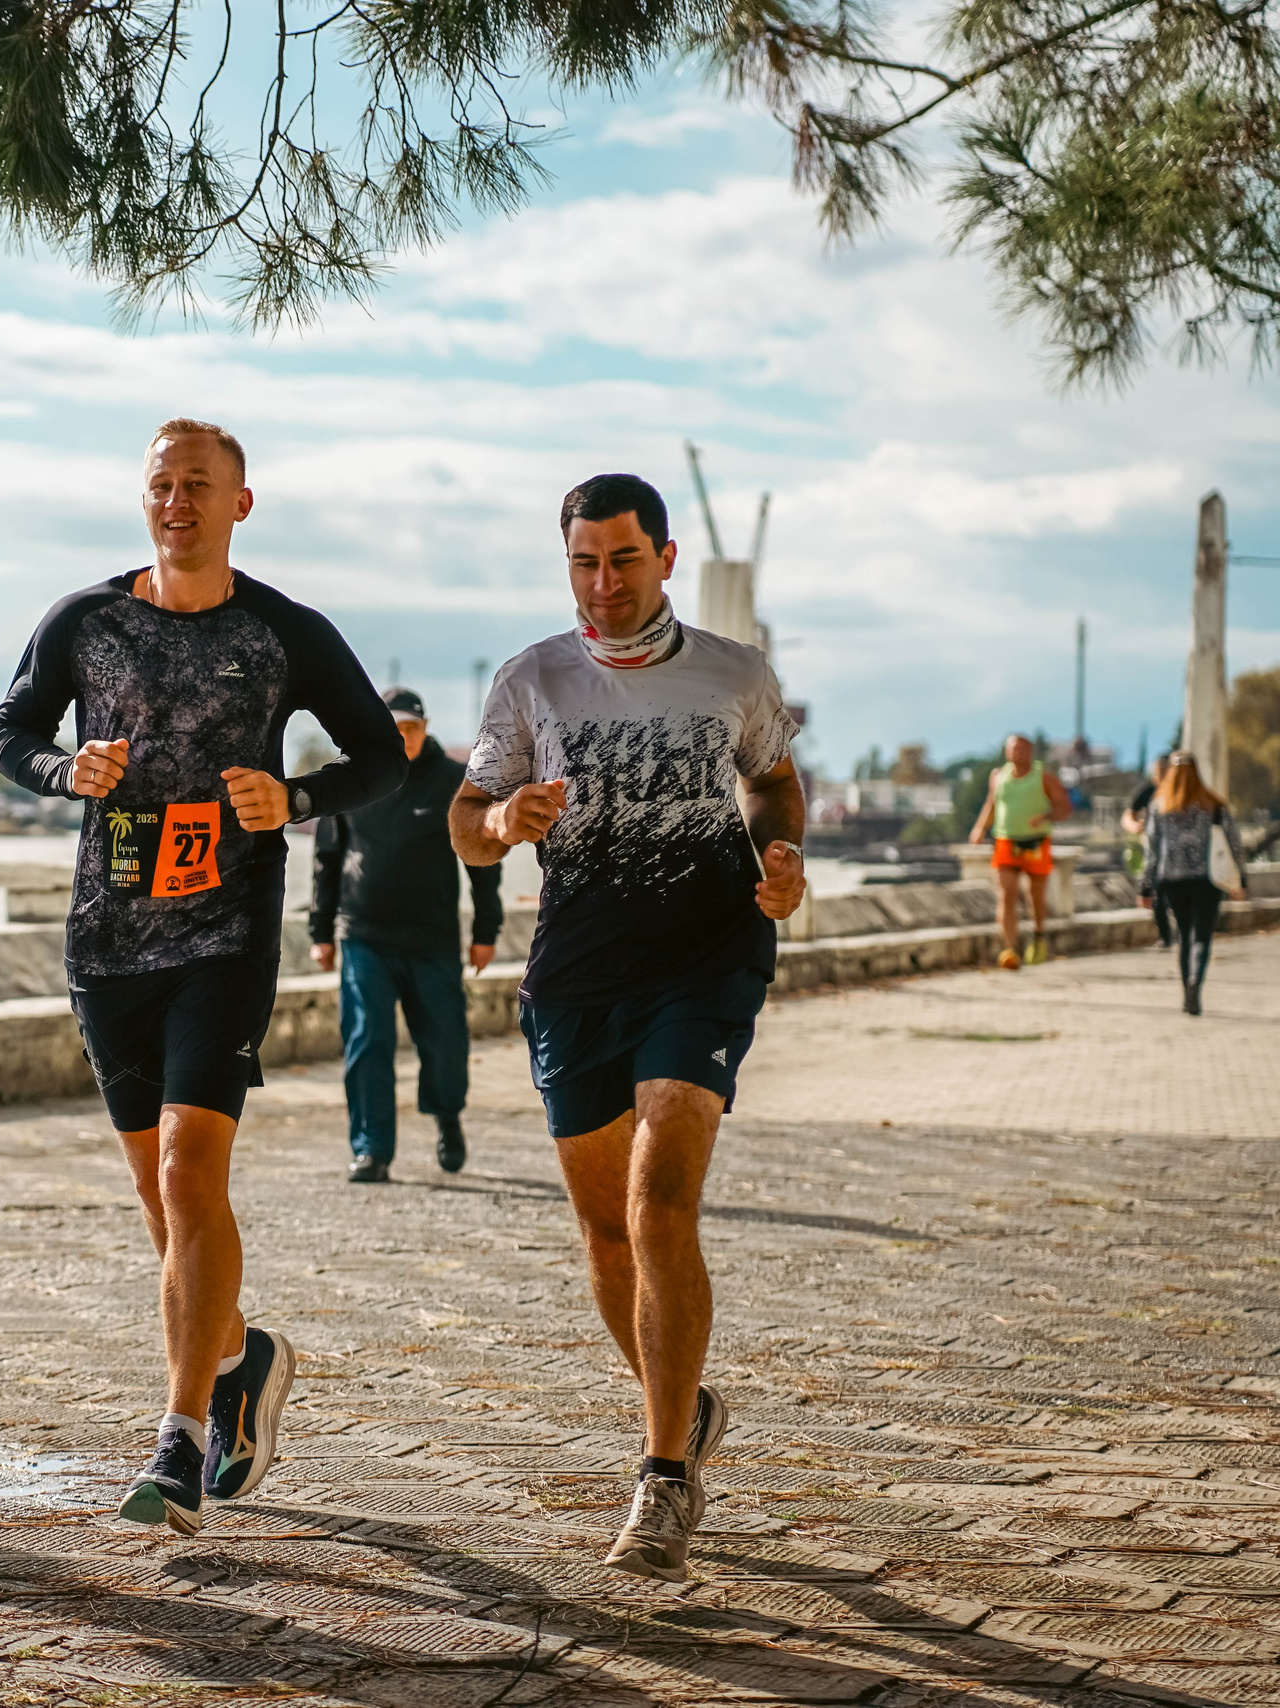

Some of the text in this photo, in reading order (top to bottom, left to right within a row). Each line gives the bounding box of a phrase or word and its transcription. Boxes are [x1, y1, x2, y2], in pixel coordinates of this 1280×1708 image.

[218, 670, 246, 678] DEMIX
[136, 813, 158, 823] 2025
[173, 821, 210, 832] Five Run
[174, 832, 211, 868] 27
[111, 858, 140, 871] WORLD
[110, 872, 140, 882] BACKYARD
